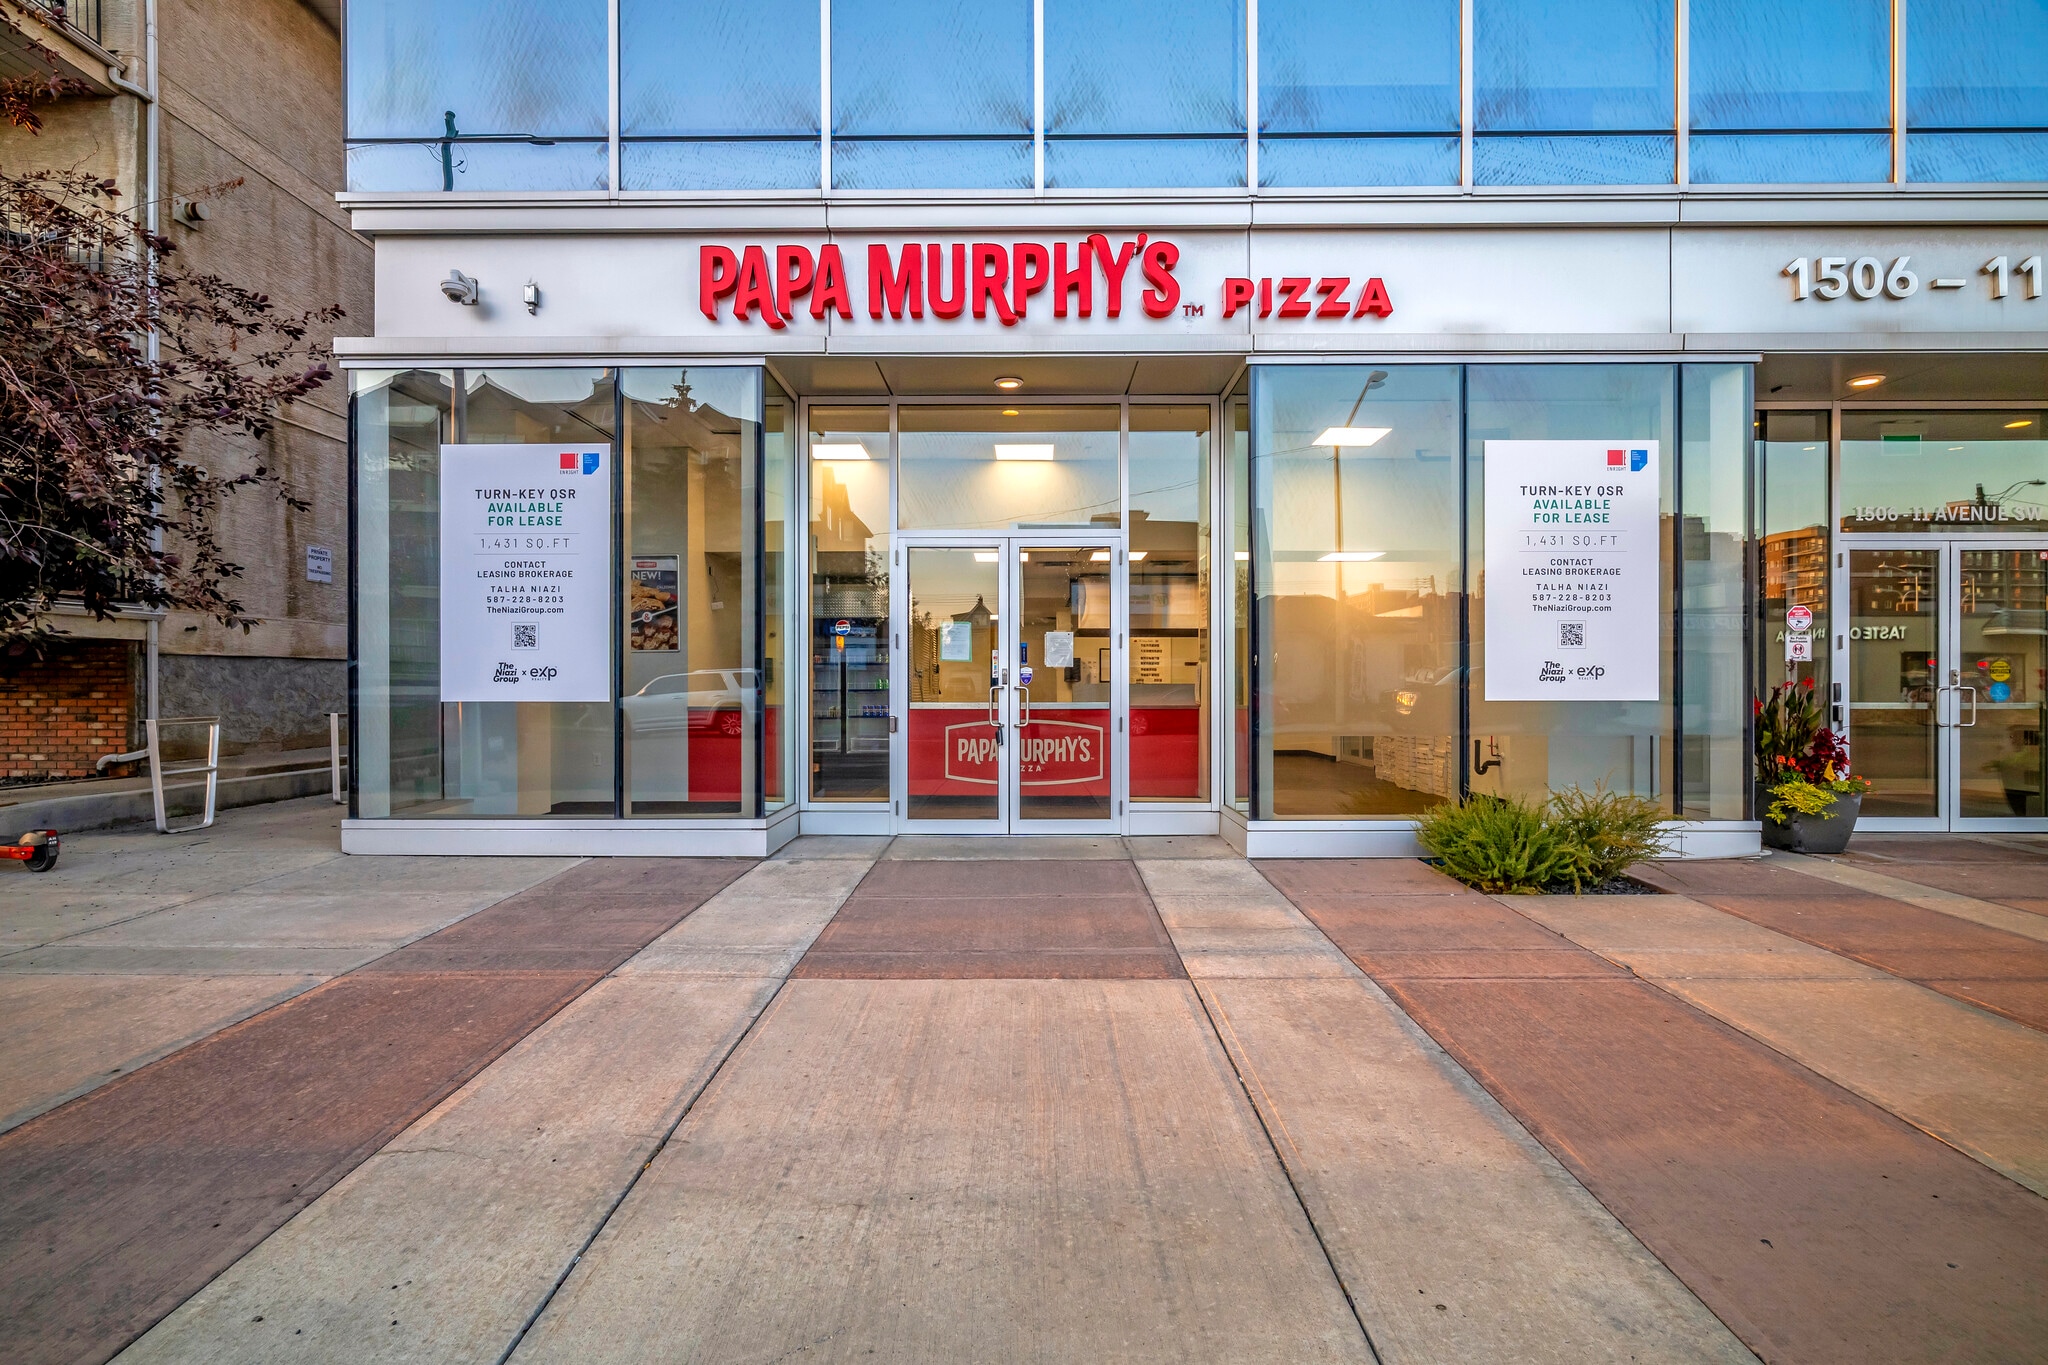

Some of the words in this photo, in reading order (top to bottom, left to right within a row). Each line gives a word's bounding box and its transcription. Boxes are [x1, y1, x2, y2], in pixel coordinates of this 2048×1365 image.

[700, 243, 853, 329] PAPA
[867, 233, 1180, 327] MURPHY'S
[1221, 277, 1394, 319] PIZZA
[1781, 256, 1919, 301] 1506
[1979, 255, 2042, 300] 11
[475, 489, 544, 499] TURN-KEY
[550, 489, 575, 500] QSR
[1520, 486, 1591, 496] TURN-KEY
[1597, 486, 1623, 497] QSR
[488, 503, 563, 512] AVAILABLE
[1533, 499, 1610, 509] AVAILABLE
[1534, 513, 1559, 523] FOR
[1566, 513, 1609, 523] LEASE
[1854, 506, 1899, 522] 1506
[1912, 506, 1931, 522] 11
[1934, 506, 2008, 522] AVENUE
[2014, 506, 2042, 522] SW
[489, 516, 513, 526] FOR
[519, 516, 562, 526] LEASE
[481, 539, 517, 549] 1,431
[526, 538, 569, 549] SQ.FT
[1527, 536, 1563, 546] 1,431
[1573, 536, 1617, 546] SQ.FT
[632, 571, 661, 581] NEW!
[487, 606, 564, 615] TheNiaziGroup.com
[1533, 604, 1611, 613] TheNiaziGroup.com
[499, 662, 514, 670] The
[1545, 661, 1560, 669] The
[496, 668, 517, 676] Niazi
[1542, 667, 1563, 675] Niazi
[493, 675, 520, 684] Group
[1539, 674, 1566, 683] Group
[958, 738, 998, 765] PAPA
[1020, 735, 1091, 765] URPHY'S
